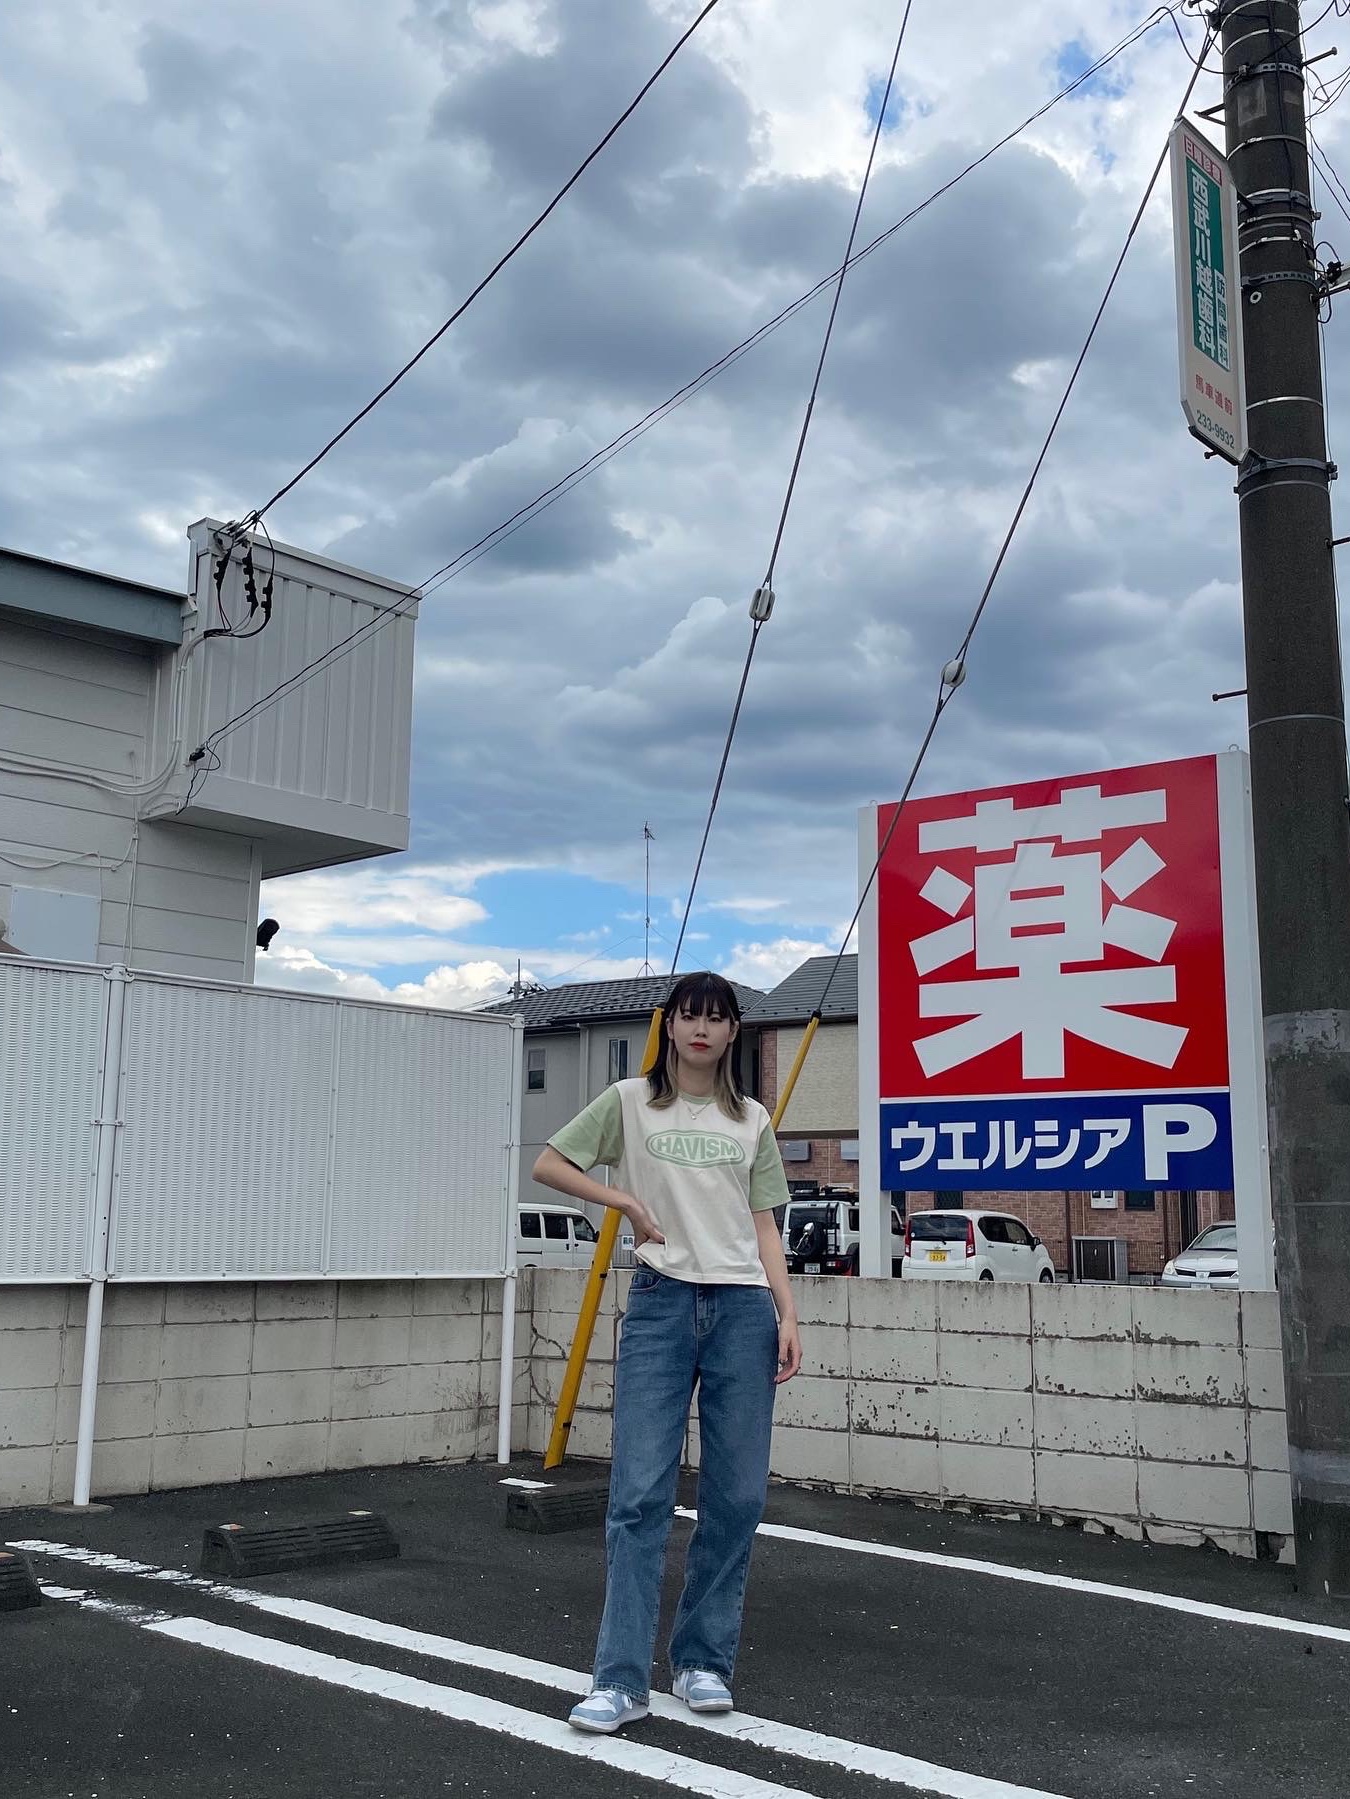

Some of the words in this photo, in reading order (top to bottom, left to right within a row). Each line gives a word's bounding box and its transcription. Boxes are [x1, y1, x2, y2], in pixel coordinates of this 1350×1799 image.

[1192, 168, 1216, 358] 西武川越歯科
[1197, 410, 1235, 449] 233-9932
[909, 785, 1190, 1079] 薬
[656, 1134, 740, 1162] HAVISM
